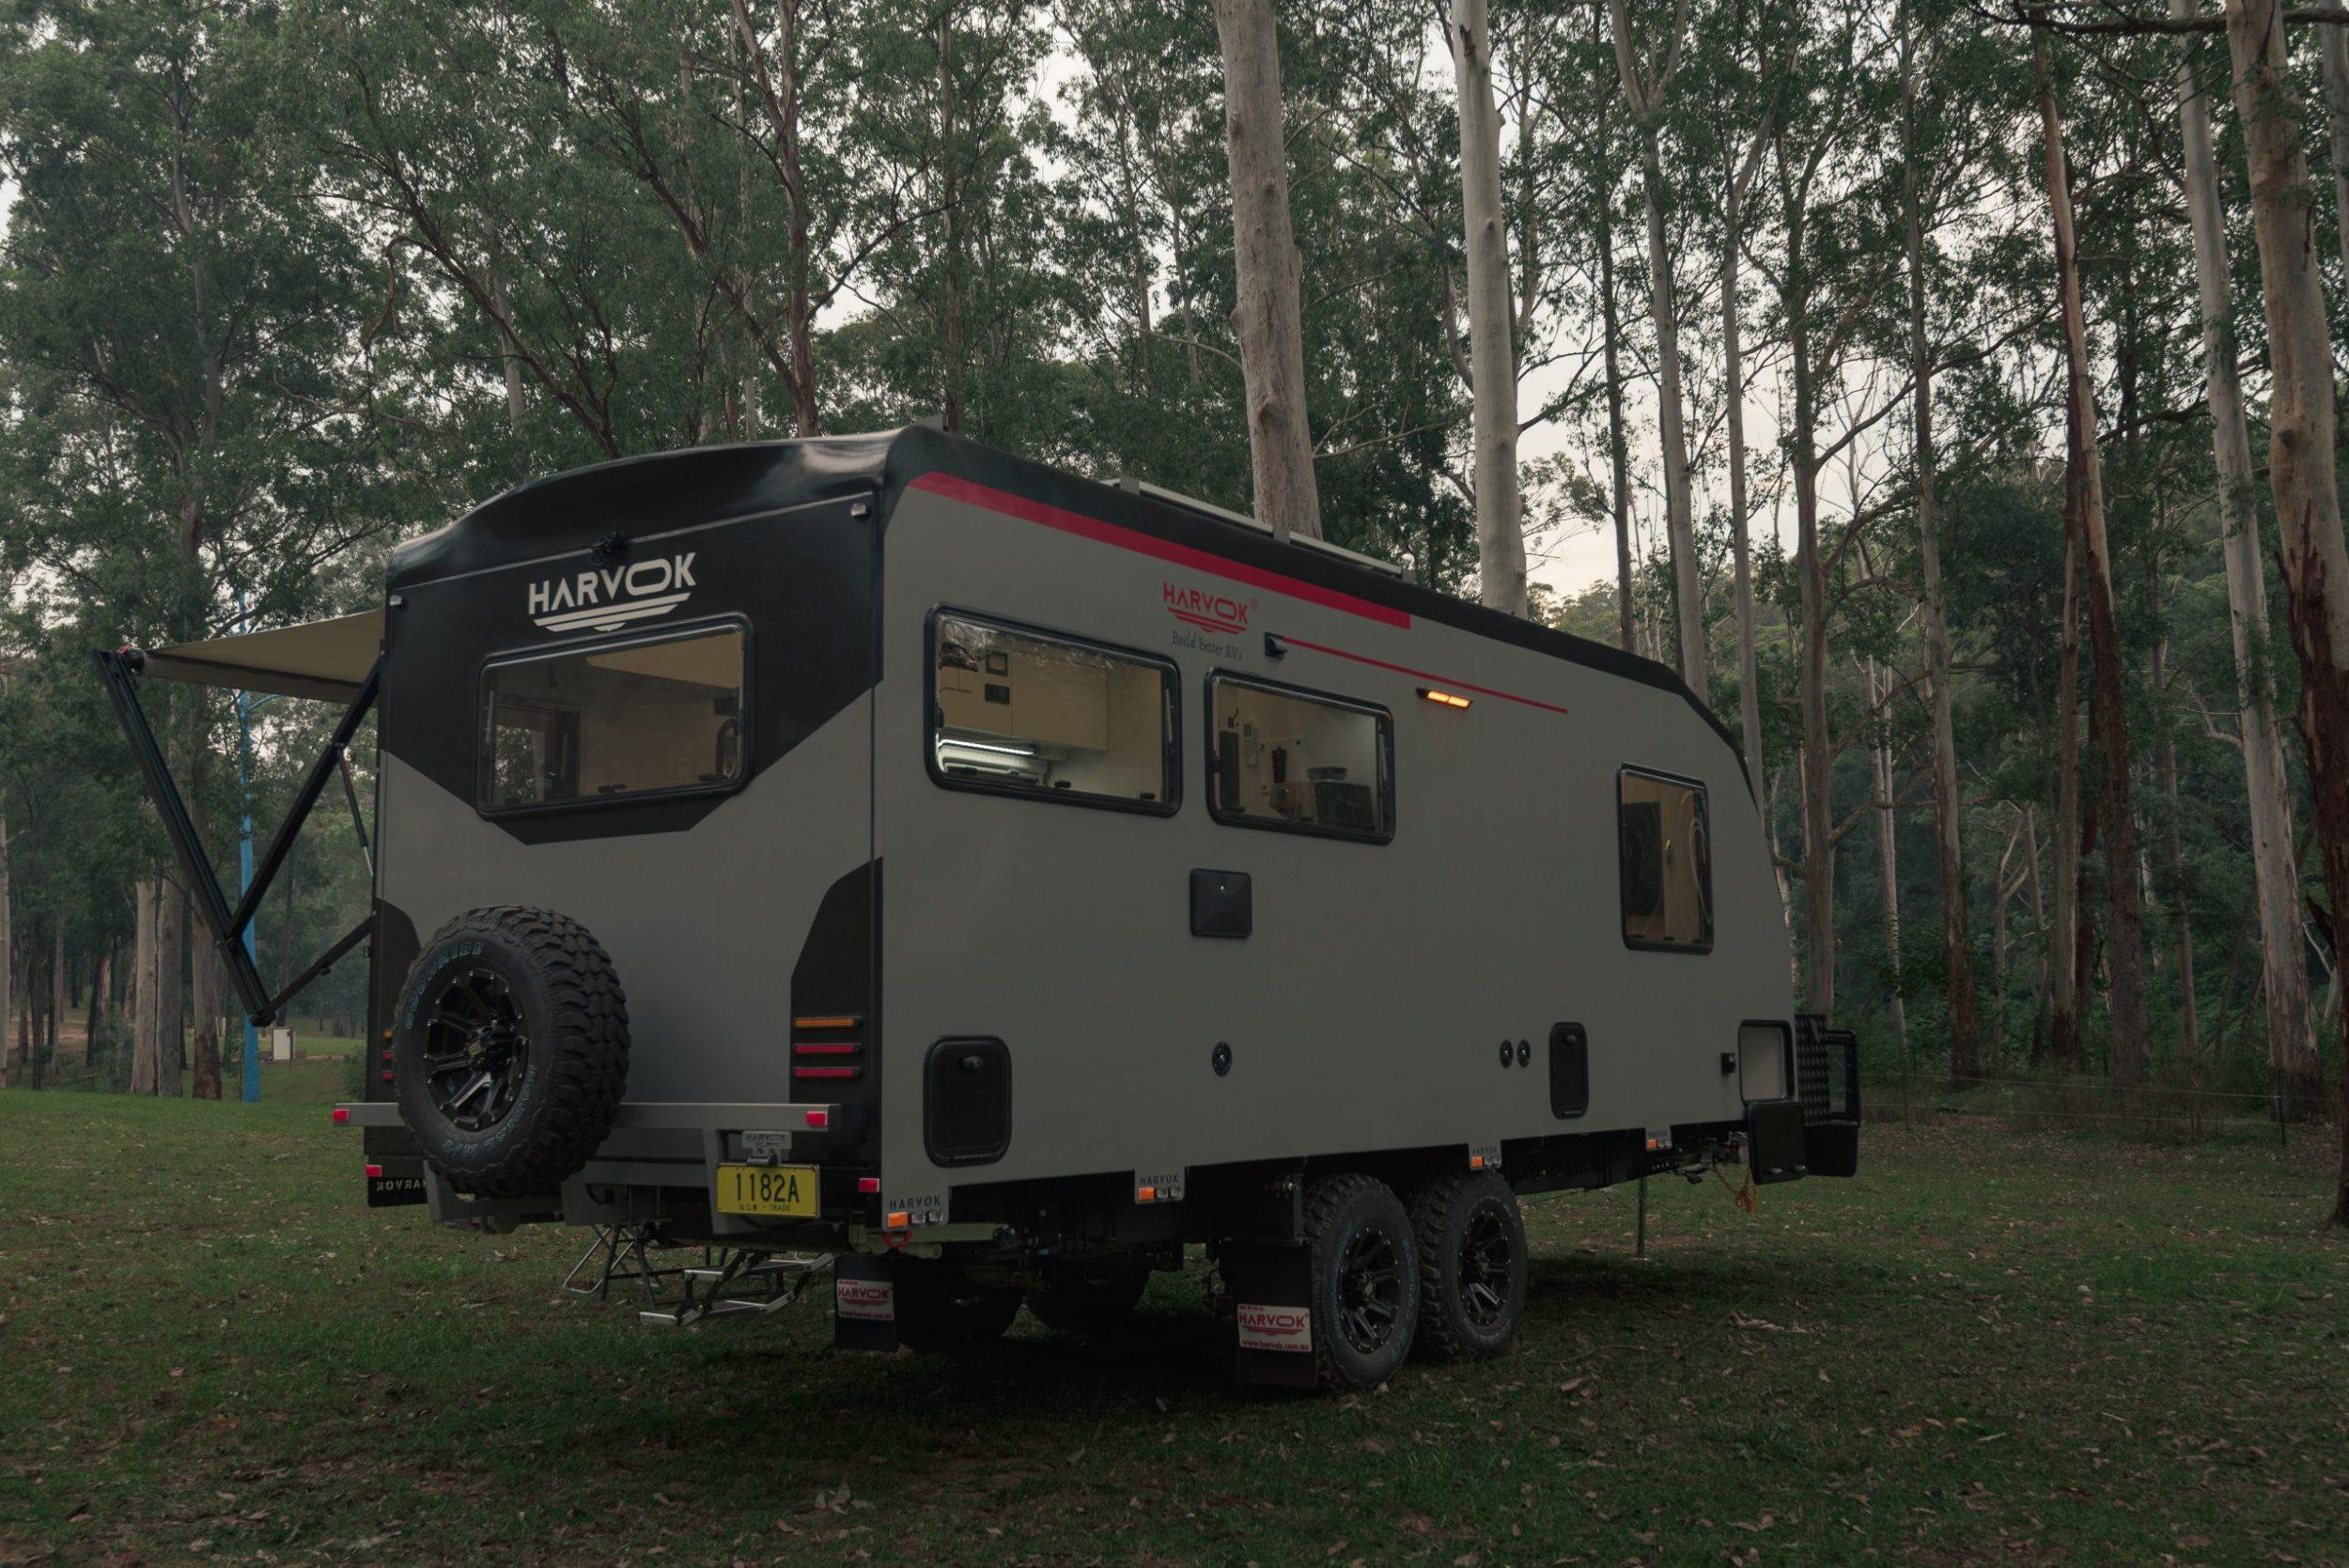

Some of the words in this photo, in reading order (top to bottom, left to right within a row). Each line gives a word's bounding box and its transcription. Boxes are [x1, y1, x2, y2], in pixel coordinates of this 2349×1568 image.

[528, 551, 697, 615] HARVOK
[1163, 582, 1249, 625] HARVOK
[1173, 630, 1196, 649] Build
[1199, 636, 1224, 656] Better
[736, 1172, 801, 1203] 1182A
[889, 1194, 941, 1210] HARVOK
[838, 1286, 890, 1300] HARVOK
[1238, 1312, 1306, 1329] HARVOK
